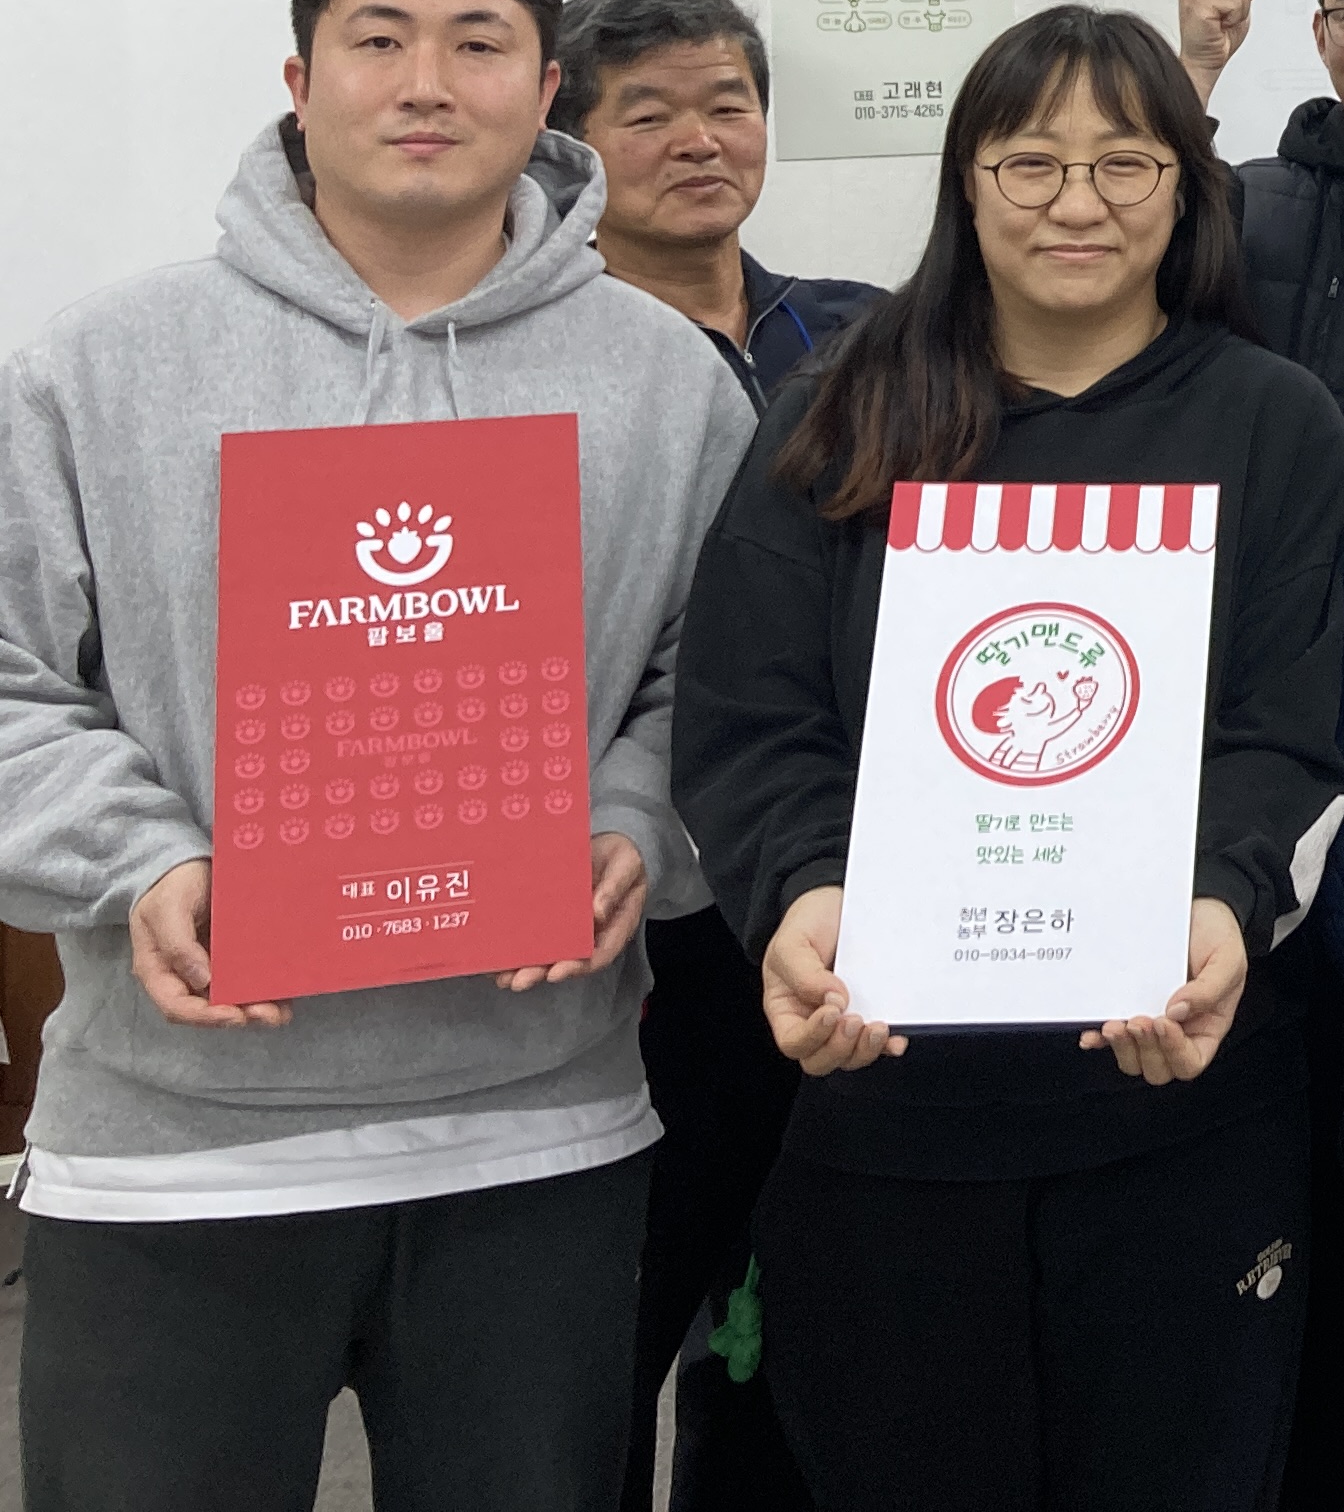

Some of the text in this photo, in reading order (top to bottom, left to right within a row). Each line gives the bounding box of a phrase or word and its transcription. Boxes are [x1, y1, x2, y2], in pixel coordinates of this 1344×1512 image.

[882, 80, 943, 100] 고래현
[854, 103, 944, 120] 010-3715-4265
[288, 584, 520, 631] FARMBOWL
[1054, 703, 1120, 767] Strawberry
[974, 811, 1075, 834] 딸기로 만드는
[976, 843, 1067, 865] 맛있는 세상
[341, 868, 471, 905] 대표 이유진
[994, 907, 1075, 934] 장은하
